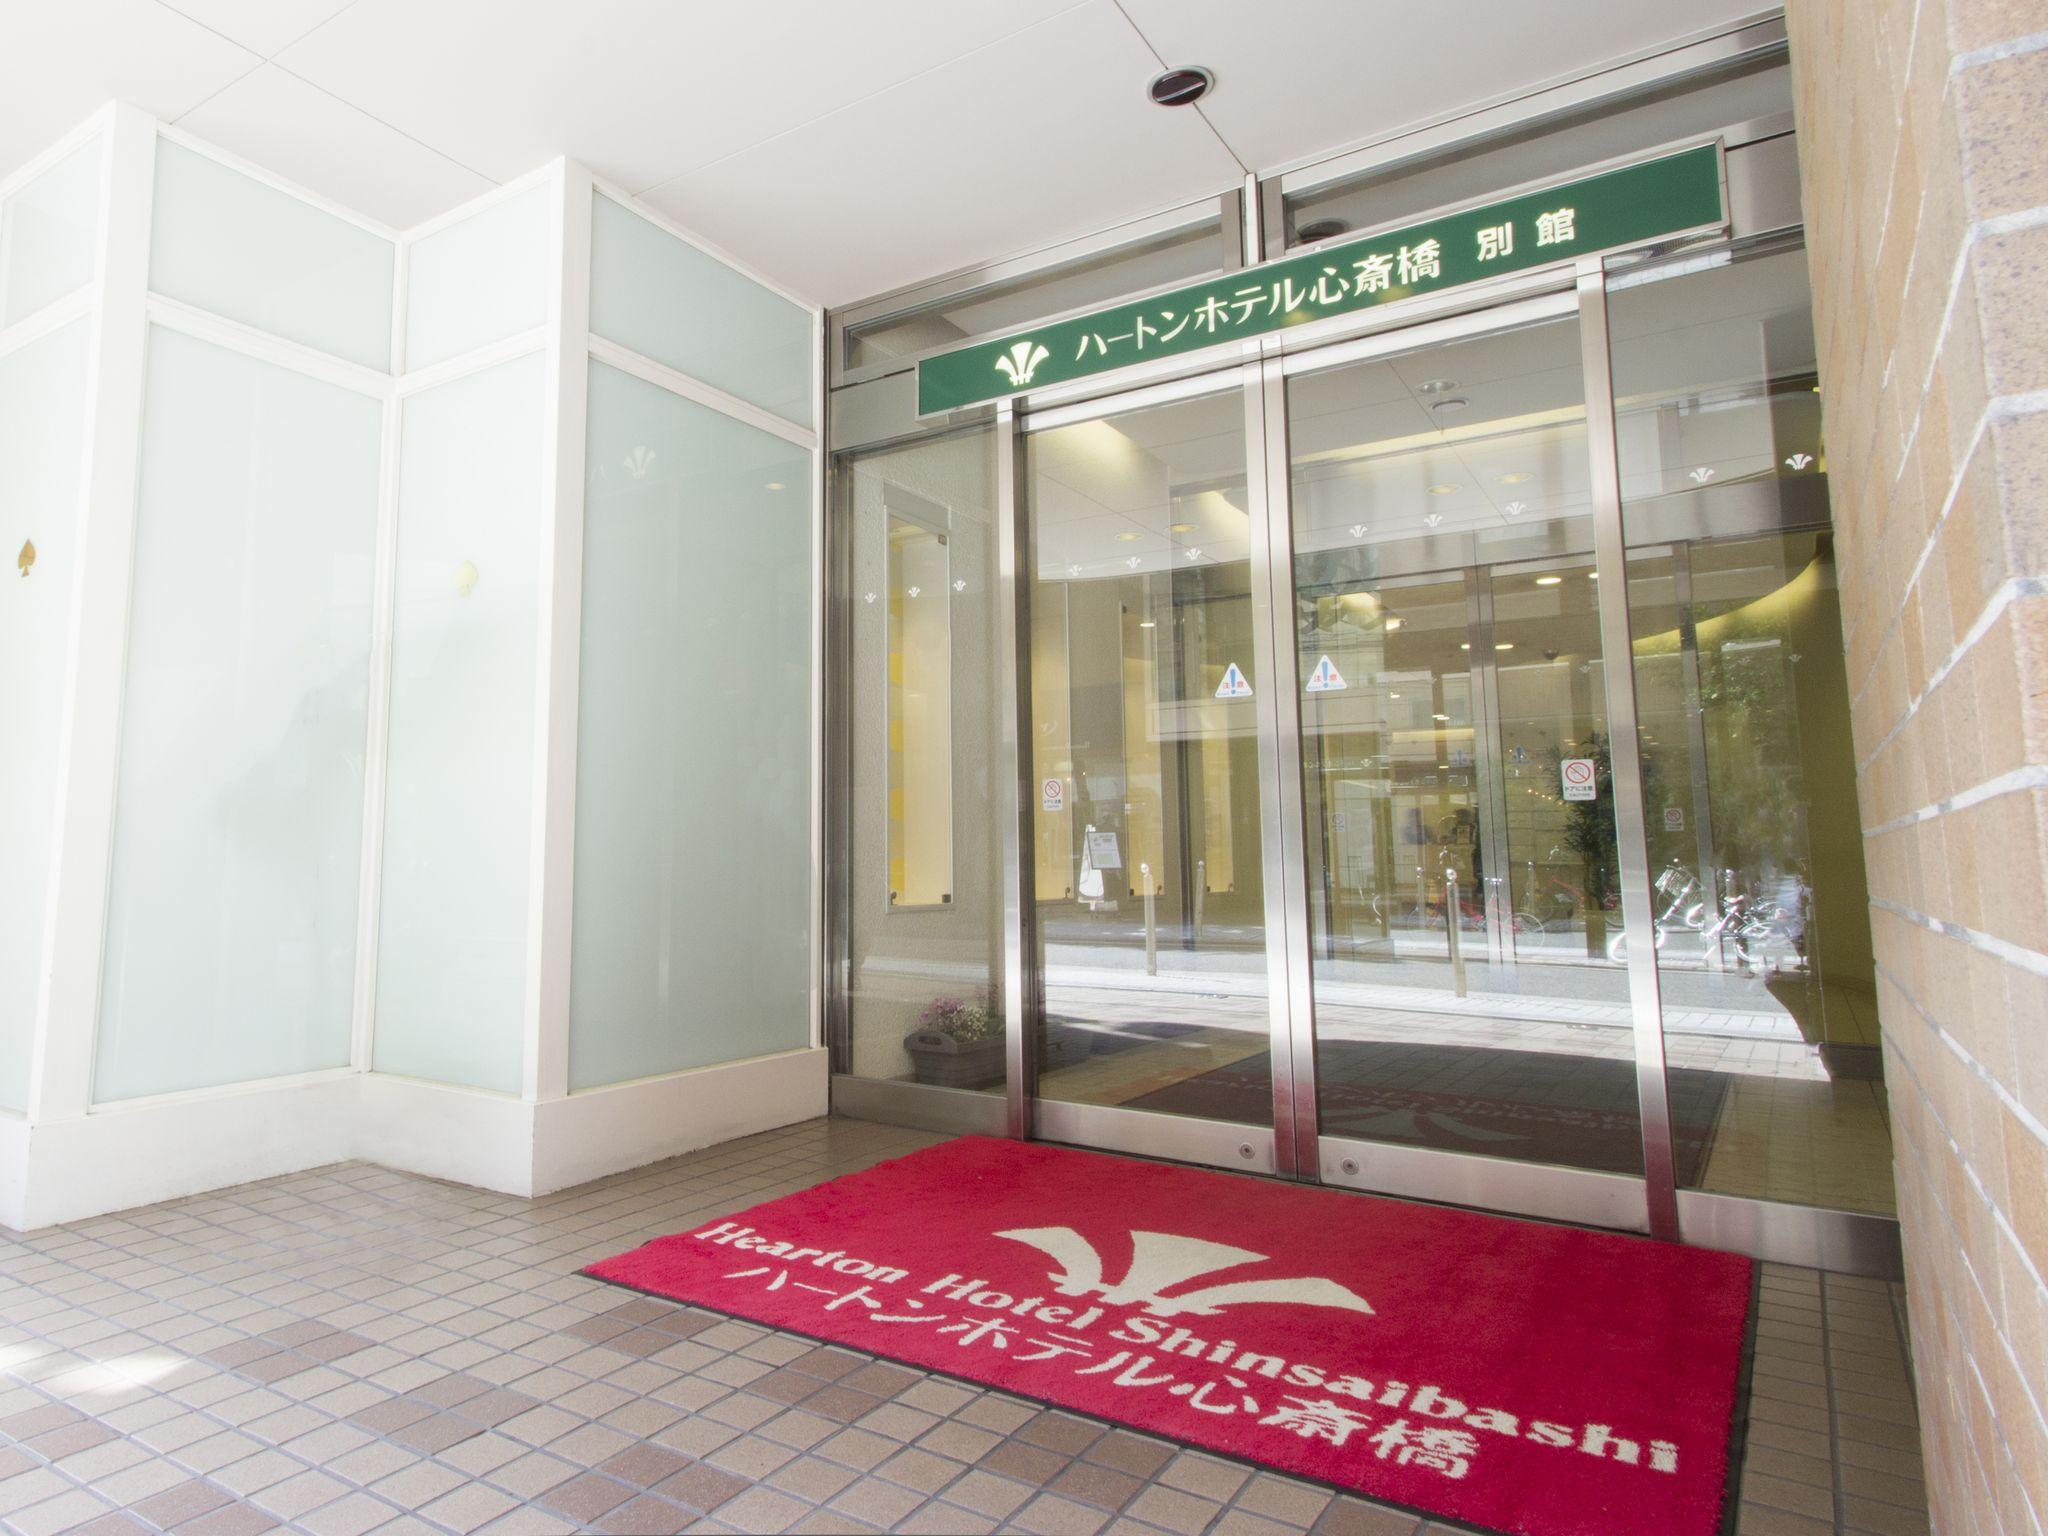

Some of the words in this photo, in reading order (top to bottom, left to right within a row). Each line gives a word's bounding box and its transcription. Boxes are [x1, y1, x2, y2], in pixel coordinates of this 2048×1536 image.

[1075, 239, 1440, 361] ハートンホテル心斎橋
[1476, 208, 1575, 261] 別館
[694, 1222, 909, 1284] Hearton
[921, 1273, 1104, 1330] Hotel
[1109, 1316, 1678, 1473] Shinsaibashi
[723, 1266, 1480, 1479] ハートンホテル心斎橋
